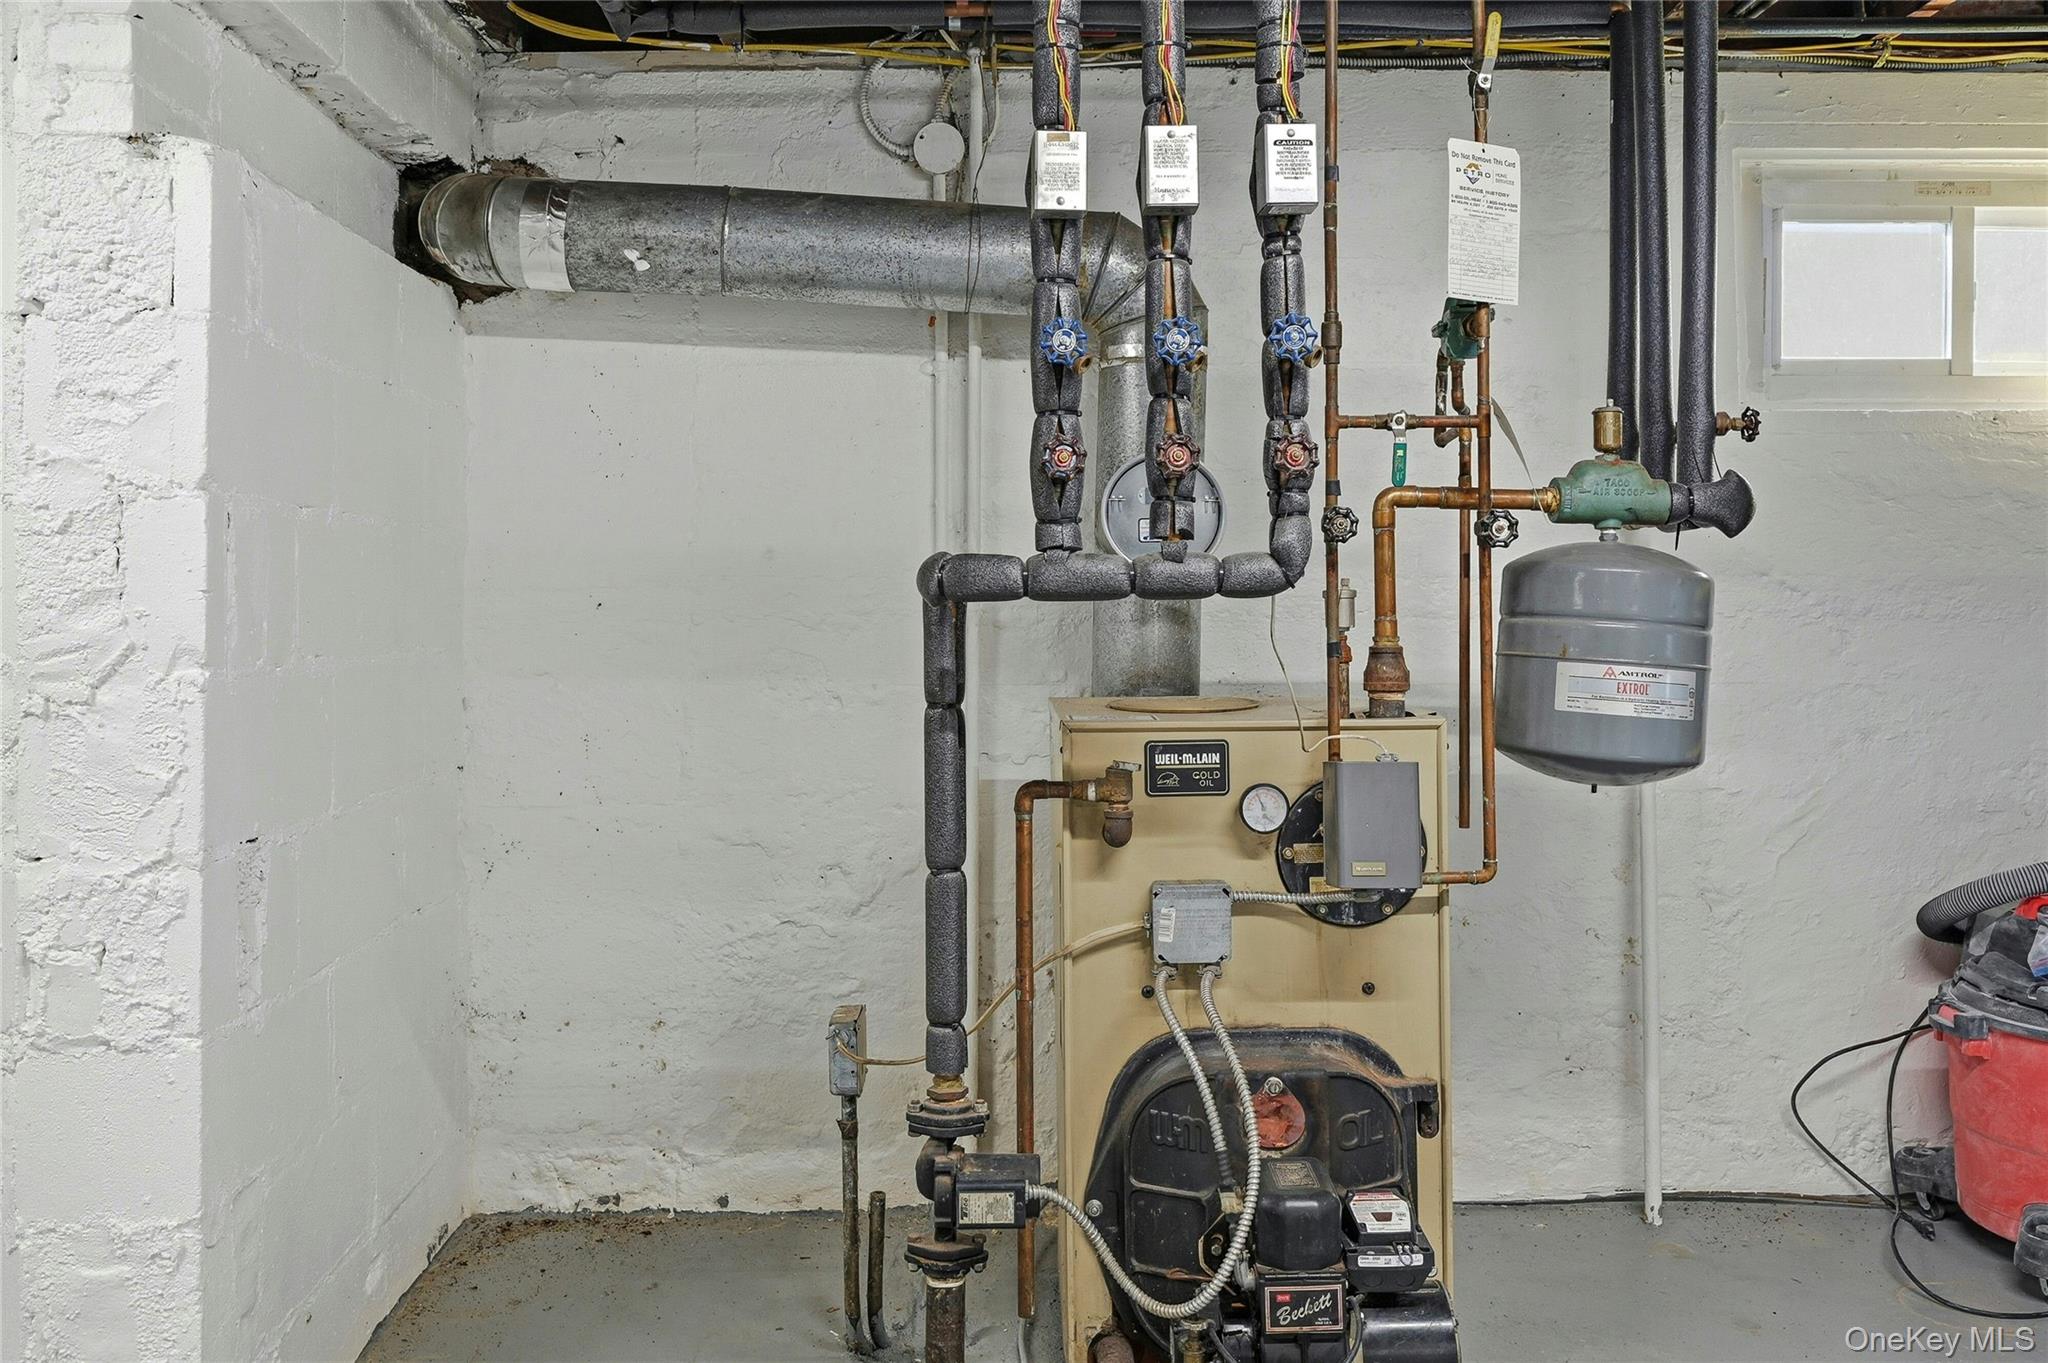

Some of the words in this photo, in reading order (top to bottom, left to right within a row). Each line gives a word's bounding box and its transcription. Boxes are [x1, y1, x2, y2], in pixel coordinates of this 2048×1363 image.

[1472, 154, 1492, 163] Remove
[1504, 160, 1516, 168] Card
[1456, 167, 1491, 178] PETRO
[1617, 670, 1659, 680] AMTROL
[1616, 682, 1649, 696] EXTROL
[1192, 771, 1221, 780] GOLD
[1276, 1292, 1333, 1326] Beckett
